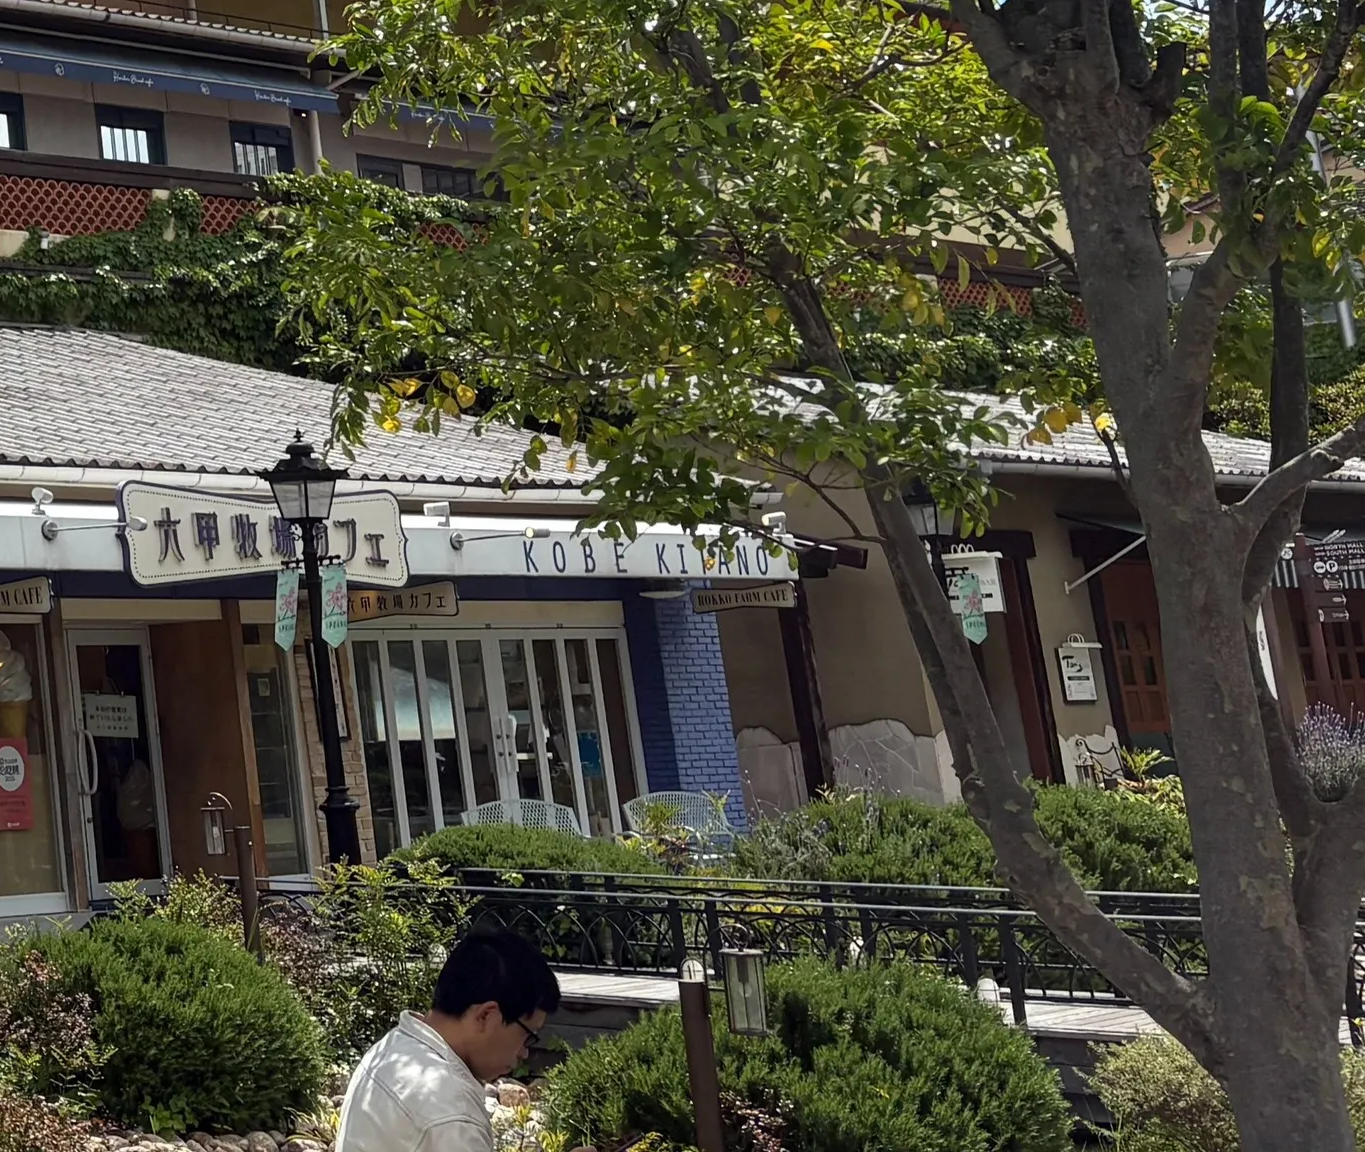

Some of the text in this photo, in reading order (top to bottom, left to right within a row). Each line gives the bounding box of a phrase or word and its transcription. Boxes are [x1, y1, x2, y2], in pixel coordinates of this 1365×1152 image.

[523, 540, 628, 573] KOBE
[14, 586, 43, 605] CAFE
[697, 588, 789, 607] ROKKO FARM CAFE
